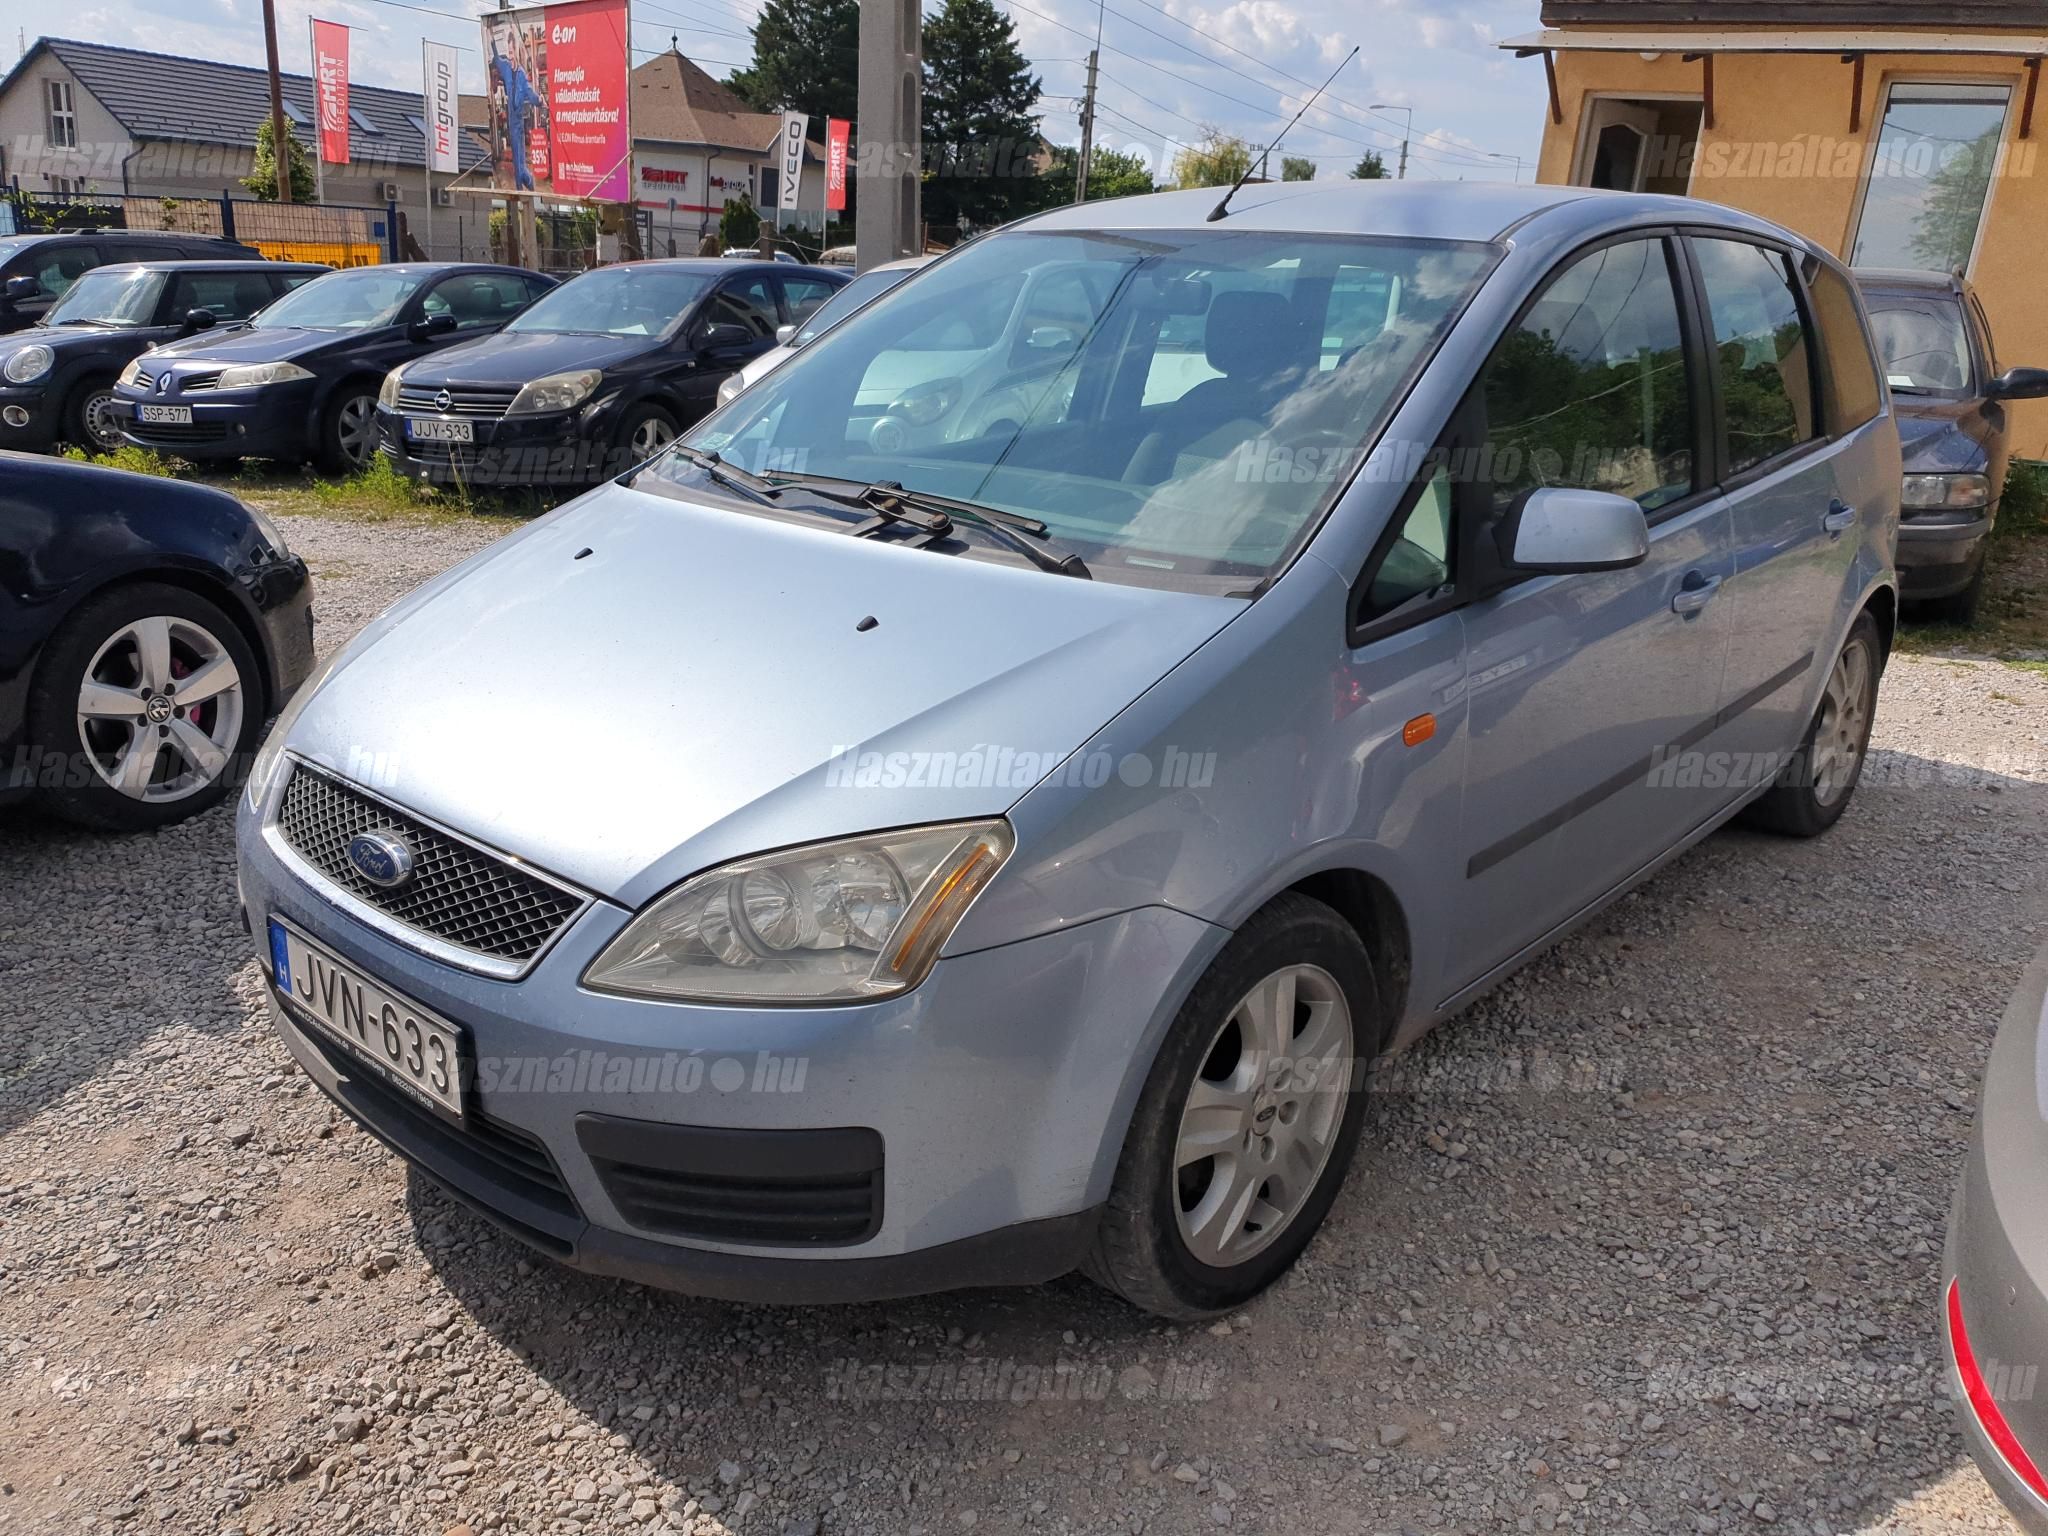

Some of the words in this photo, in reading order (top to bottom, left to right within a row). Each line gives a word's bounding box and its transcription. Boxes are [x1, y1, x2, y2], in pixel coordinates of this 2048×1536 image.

[320, 51, 337, 103] HRT
[336, 59, 345, 132] SPEDITION
[434, 61, 453, 155] hrtgroup
[554, 66, 585, 85] Hangolja
[784, 121, 801, 202] IVECO
[143, 407, 188, 421] SSP-577
[279, 963, 287, 983] H
[296, 952, 449, 1095] JVN-633
